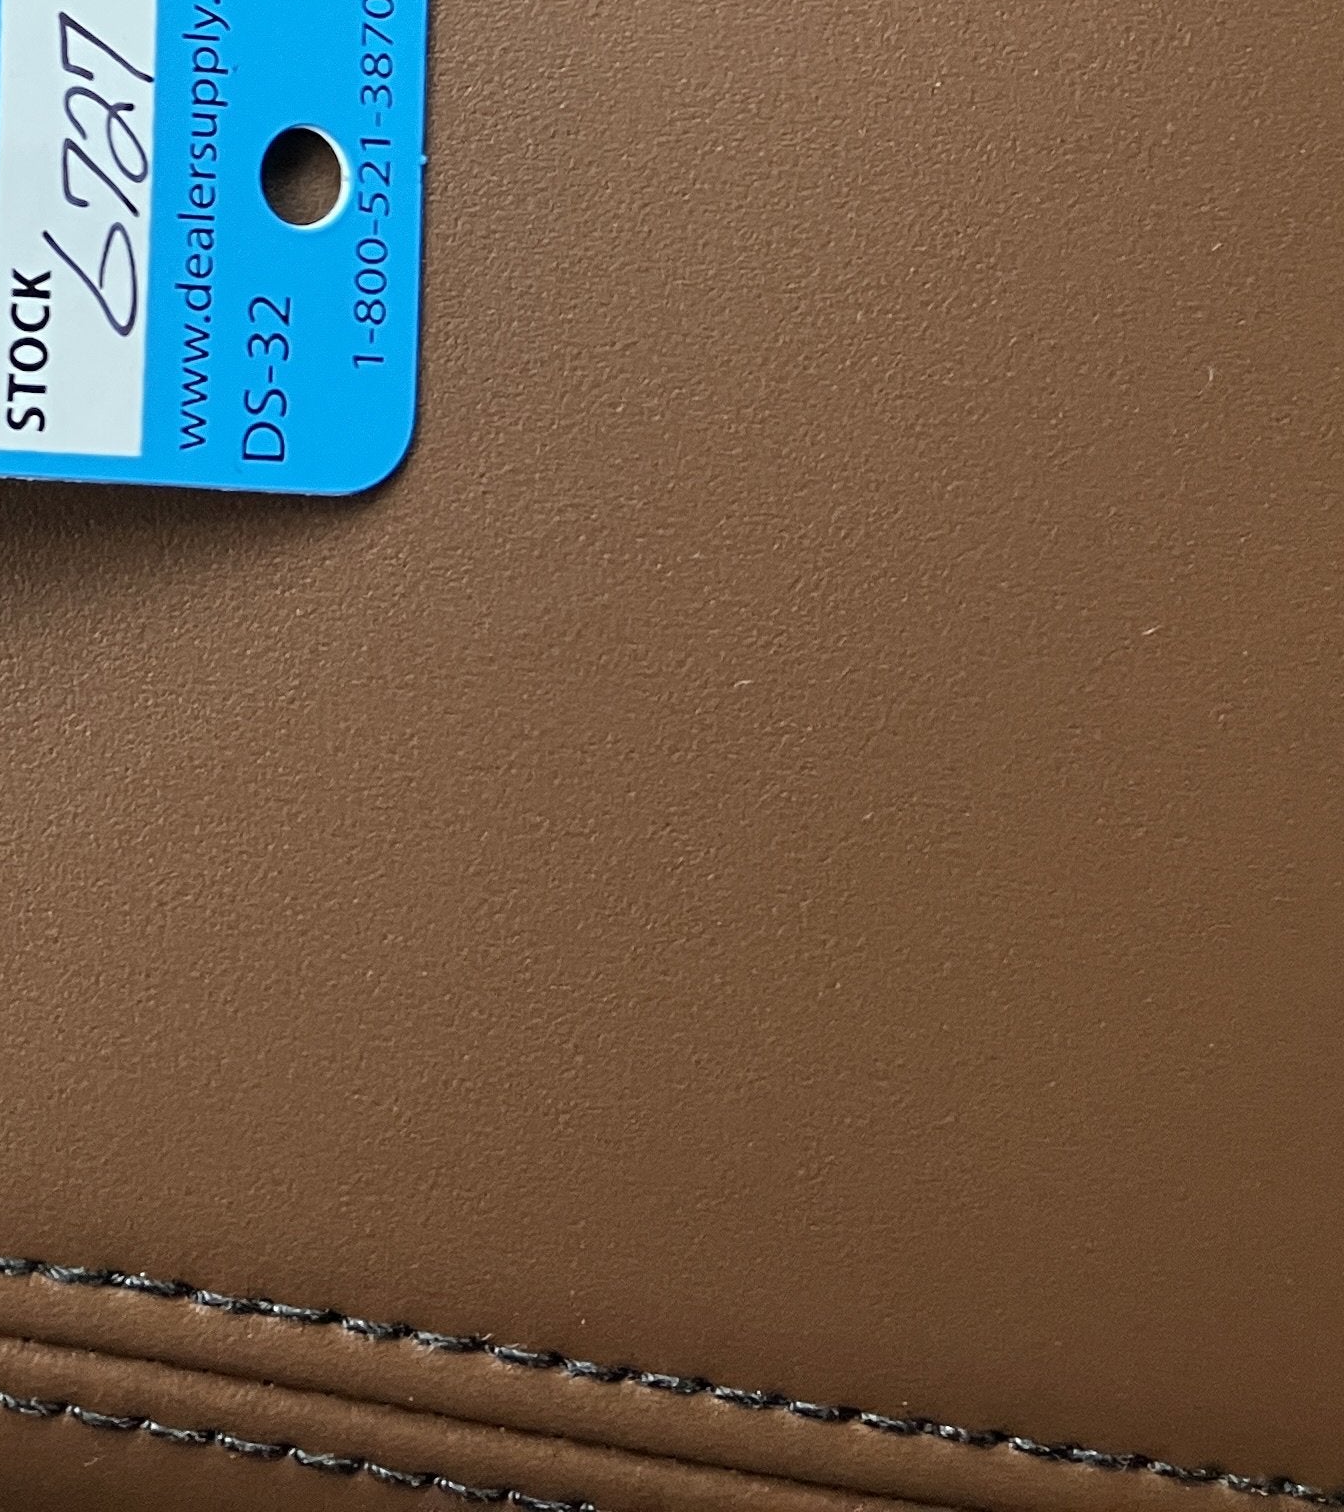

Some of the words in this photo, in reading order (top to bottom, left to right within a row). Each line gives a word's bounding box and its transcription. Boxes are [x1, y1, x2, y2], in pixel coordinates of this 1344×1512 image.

[41, 10, 156, 337] 6727
[6, 267, 54, 433] STOCK
[242, 293, 292, 465] DS-32
